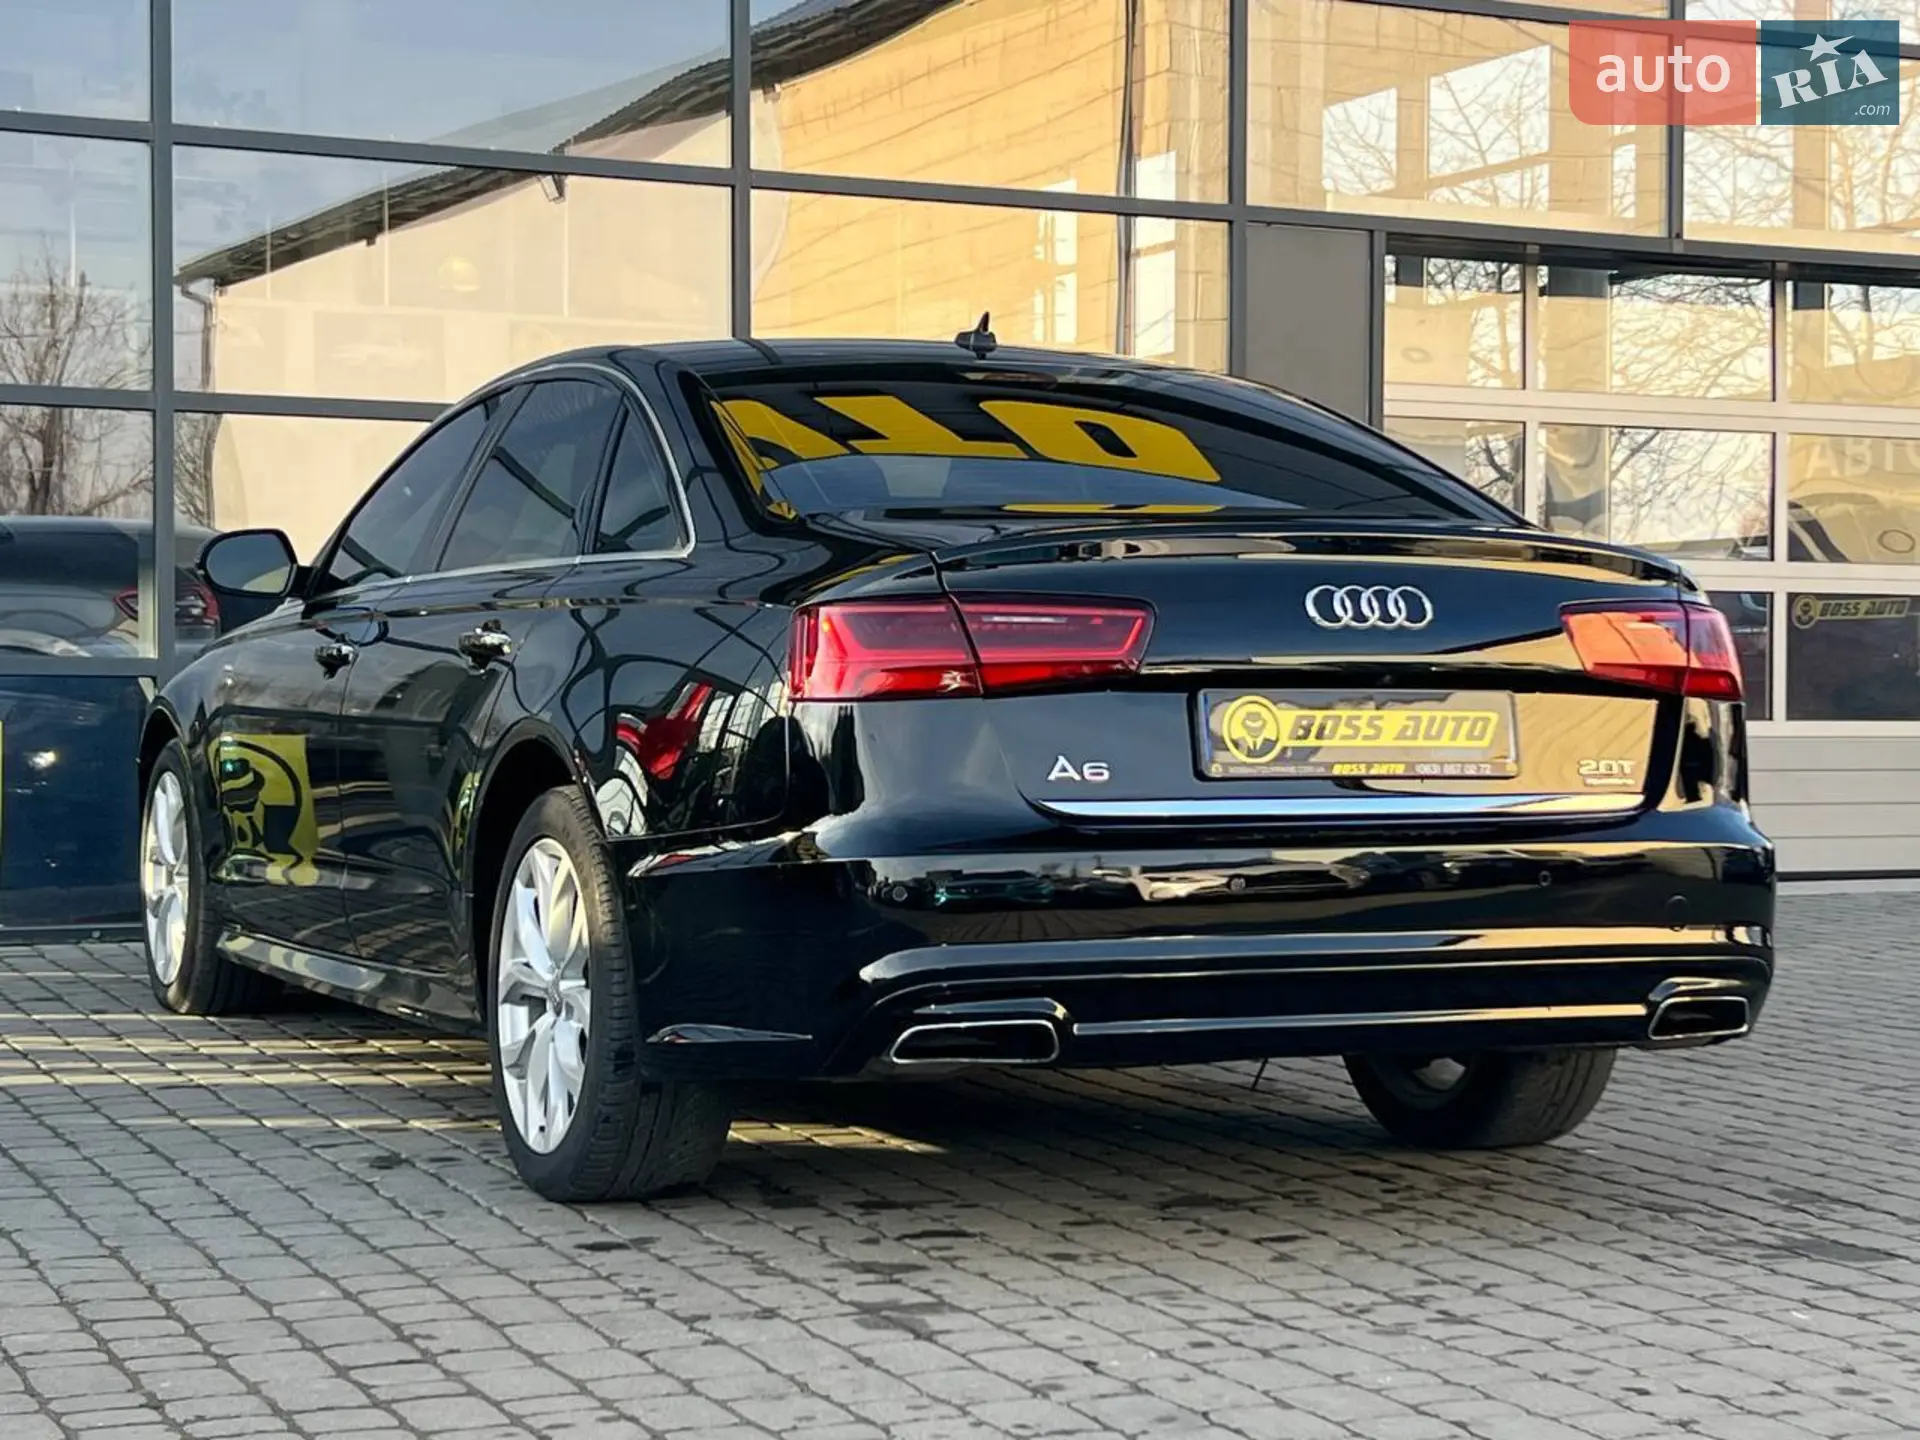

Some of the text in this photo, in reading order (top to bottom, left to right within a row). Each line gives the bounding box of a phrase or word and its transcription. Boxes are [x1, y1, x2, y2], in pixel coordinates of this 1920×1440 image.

[1819, 600, 1908, 617] BOSS AUTO
[1288, 714, 1492, 741] BOSS AUTO
[1046, 755, 1110, 781] A6
[1332, 762, 1367, 775] BOSS
